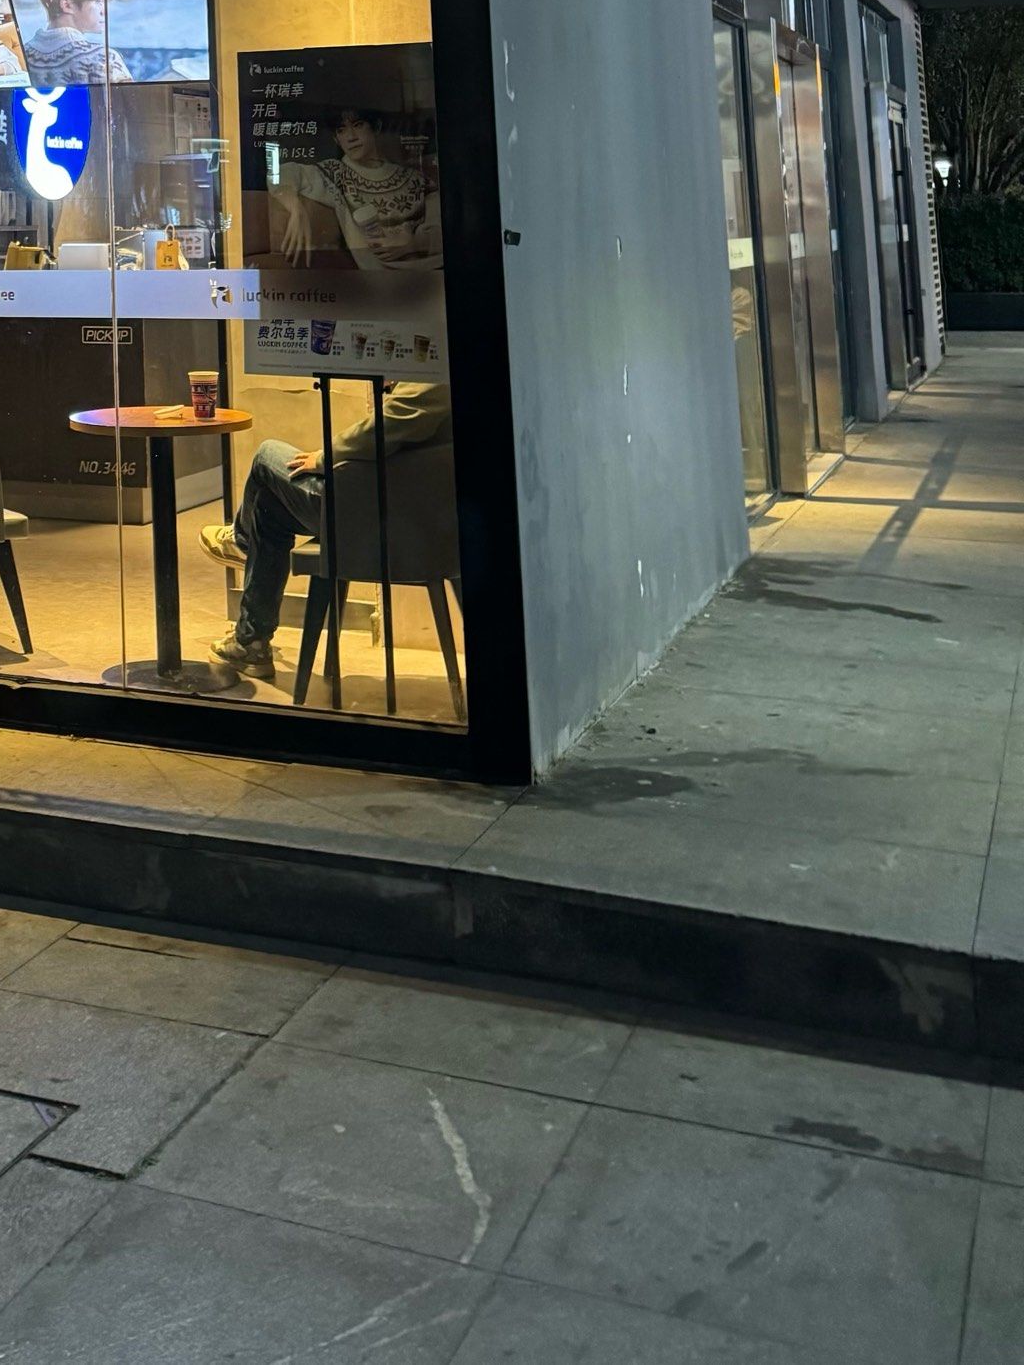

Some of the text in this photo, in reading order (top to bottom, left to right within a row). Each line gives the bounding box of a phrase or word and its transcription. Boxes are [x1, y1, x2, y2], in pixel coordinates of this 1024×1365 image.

[251, 83, 305, 99] 一杯瑞幸
[251, 103, 278, 118] 开启
[252, 120, 318, 137] 暖暖费尔岛
[291, 147, 316, 159] ISLE
[242, 288, 337, 303] luckin coffee
[257, 325, 309, 340] 费尔岛季
